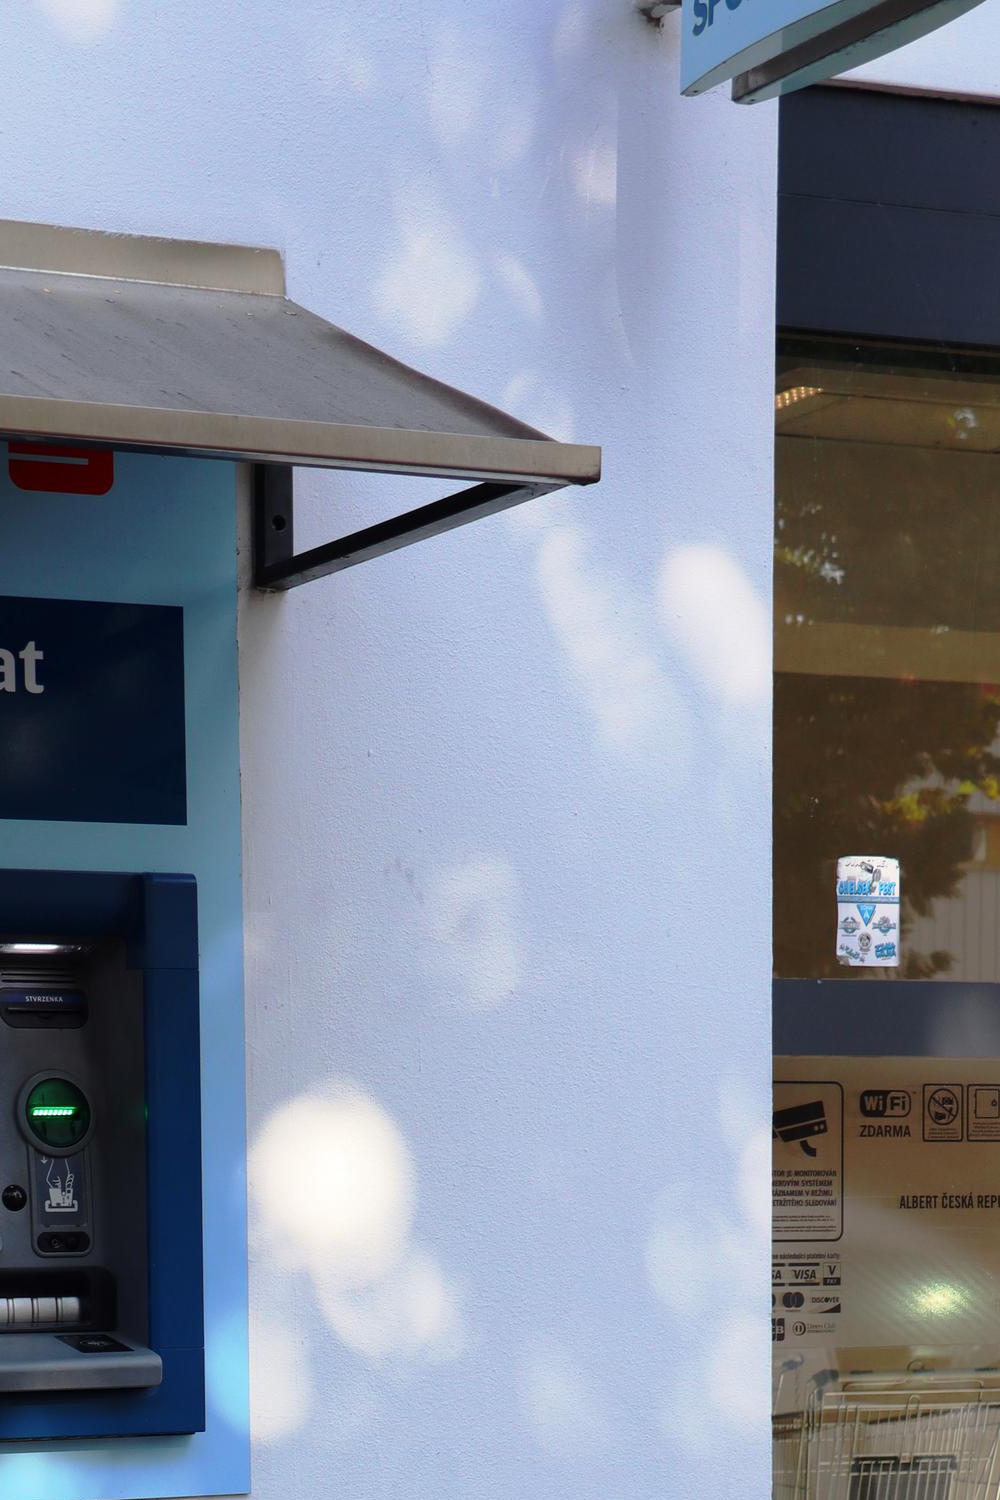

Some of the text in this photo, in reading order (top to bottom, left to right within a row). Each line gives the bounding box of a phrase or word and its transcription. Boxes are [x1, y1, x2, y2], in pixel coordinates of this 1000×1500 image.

[25, 995, 64, 1003] STVRZENKA
[859, 1125, 912, 1138] ZDARMA
[899, 1195, 939, 1209] ALBERT
[941, 1191, 974, 1209] ČESKÁ
[792, 1269, 817, 1280] VISA
[828, 1265, 837, 1276] V
